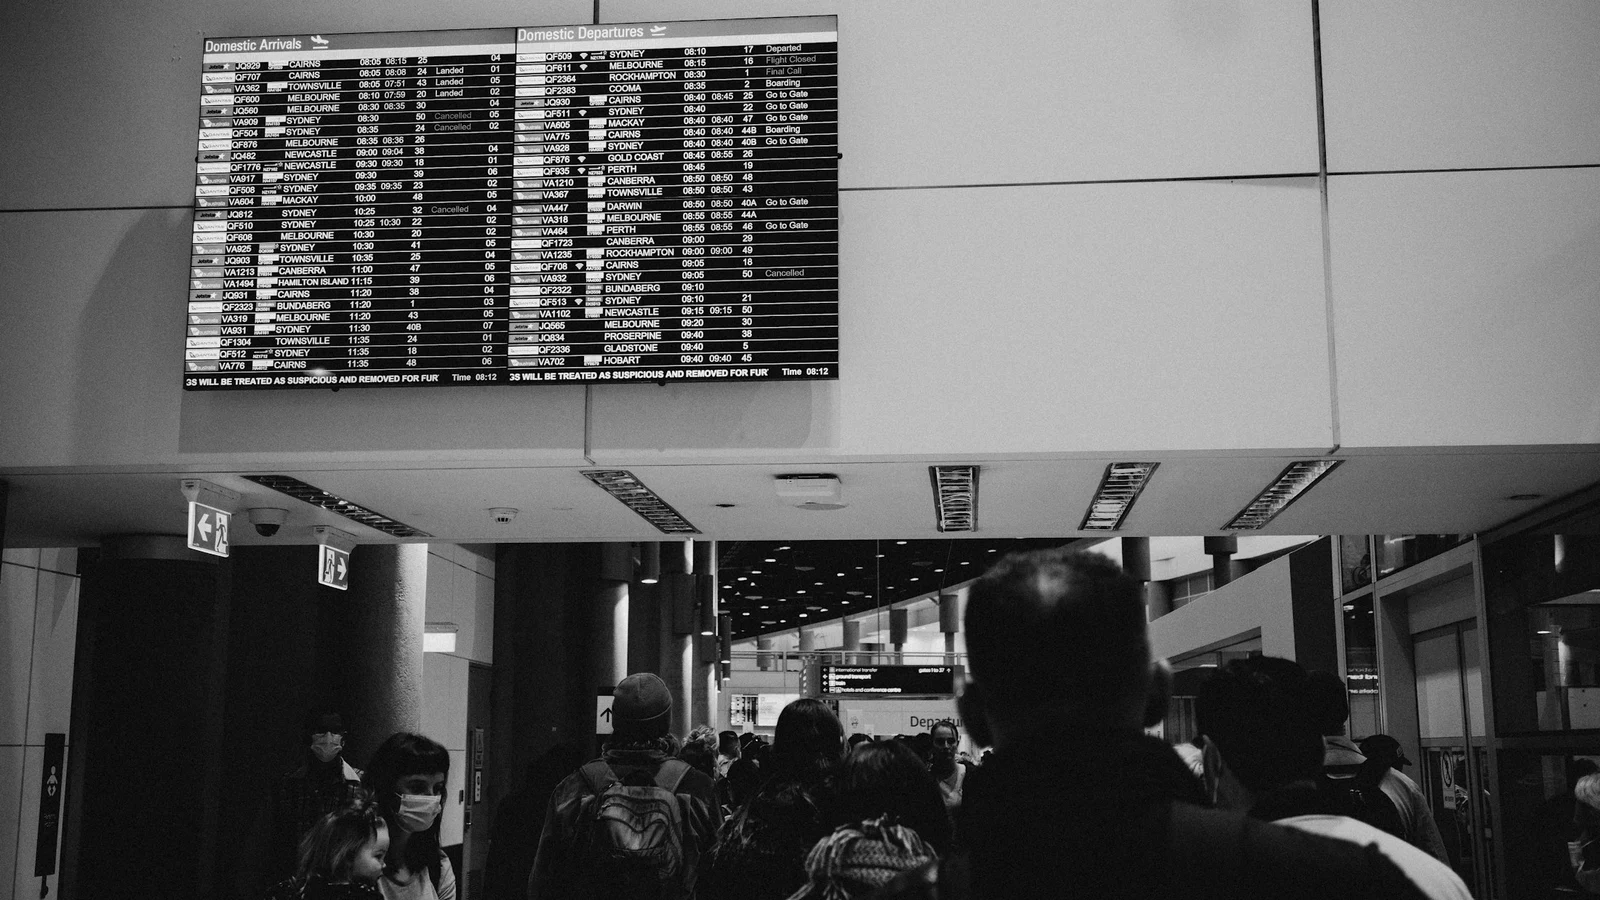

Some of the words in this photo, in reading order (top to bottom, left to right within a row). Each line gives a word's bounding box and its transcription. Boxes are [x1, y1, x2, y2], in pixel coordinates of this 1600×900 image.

[518, 27, 575, 41] Domestic
[578, 26, 644, 39] Departures
[205, 39, 257, 52] Domestic
[259, 38, 302, 50] Arrivals
[546, 52, 572, 61] QF509
[609, 50, 645, 58] SYDNEY
[766, 44, 801, 53] Departed
[235, 61, 261, 70] JQ929
[289, 60, 321, 68] CAIRNS
[609, 60, 663, 70] MELBOURNE
[766, 56, 787, 65] Flight
[789, 55, 816, 63] Closed
[235, 73, 261, 81] QF707
[288, 71, 320, 79] CAIRNS
[436, 66, 464, 75] Landed
[609, 72, 676, 81] ROCKHAMPTON
[786, 67, 802, 75] Call
[288, 82, 342, 90] TOWNSVILLE
[435, 78, 464, 86] Landed
[609, 84, 642, 93] COOMA
[766, 79, 801, 87] Boarding
[287, 93, 340, 102] MELBOURNE
[384, 91, 406, 99] 07:59
[435, 89, 463, 97] Landed
[545, 98, 570, 106] JQ930
[608, 96, 641, 104] CAIRNS
[765, 91, 778, 99] Go
[789, 90, 808, 98] Gate
[287, 104, 340, 113] MELBOURNE
[545, 110, 570, 118] QF511
[608, 107, 644, 116] SYDNEY
[232, 118, 259, 126] VA909
[286, 116, 321, 124] SYDNEY
[434, 112, 472, 120] Cancelled
[608, 119, 645, 127] MACKAY
[286, 128, 321, 136] SYDNEY
[434, 123, 472, 131] Cancelled
[608, 130, 641, 139] CAIRNS
[765, 125, 801, 134] Boarding
[285, 138, 338, 147] MELBOURNE
[608, 142, 644, 150] SYDNEY
[285, 150, 337, 158] NEWCASTLE
[608, 154, 633, 162] GOLD
[634, 153, 665, 161] COAST
[230, 163, 261, 172] QF1776
[284, 161, 336, 170] NEWCASTLE
[355, 160, 378, 168] 09:30
[607, 165, 637, 173] PERTH
[229, 175, 256, 183] VA917
[283, 173, 319, 181] SYDNEY
[543, 179, 574, 187] VA1210
[607, 176, 656, 185] CANBERRA
[283, 184, 318, 193] SYDNEY
[607, 188, 663, 197] TOWNSVILLE
[282, 196, 319, 204] MACKAY
[355, 194, 376, 202] 10:00
[542, 204, 569, 212] VA447
[607, 202, 642, 210] DARWIN
[765, 198, 778, 206] Go
[779, 198, 788, 206] to
[281, 209, 317, 217] SYDNEY
[354, 207, 376, 215] 10:25
[607, 213, 661, 222] MELBOURNE
[281, 220, 317, 229] SYDNEY
[606, 226, 636, 234] PERTH
[280, 232, 334, 240] MELBOURNE
[541, 239, 573, 248] QF1723
[606, 237, 655, 246] CANBERRA
[280, 244, 315, 252] SYDNEY
[541, 251, 572, 259] VA1235
[606, 248, 674, 257] ROCKHAMPTON
[225, 256, 251, 265] JQ903
[279, 254, 334, 263] TOWNSVILLE
[352, 254, 374, 262] 10:35
[224, 268, 255, 276] VA1213
[278, 267, 326, 275] CANBERRA
[351, 265, 373, 273] 11:00
[540, 262, 568, 271] QF708
[605, 261, 639, 269] CAIRNS
[605, 273, 642, 281] SYDNEY
[765, 269, 805, 277] Cancelled
[223, 280, 254, 288] VA1494
[278, 278, 319, 286] HAMILTON
[351, 277, 373, 285] 11:15
[605, 284, 661, 293] BUNDABERG
[681, 283, 704, 291] 09:10
[222, 291, 248, 300] JQ931
[277, 290, 310, 298] CAIRNS
[222, 303, 253, 311] QF2323
[277, 301, 331, 310] BUNDABERG
[540, 298, 567, 306] QF513
[605, 296, 641, 305] SYDNEY
[539, 310, 571, 318] VA1102
[605, 308, 659, 316] NEWCASTLE
[681, 307, 704, 315] 09:15
[709, 306, 732, 314] 09:15
[276, 313, 330, 322] MELBOURNE
[275, 325, 311, 333] SYDNEY
[604, 320, 660, 328] MELBOURNE
[220, 338, 251, 347] QF1304
[275, 337, 330, 345] TOWNSVILLE
[348, 336, 370, 344] 11:35
[539, 333, 565, 342] JQ834
[604, 332, 662, 340] PROSERPINE
[604, 344, 658, 352] GLADSTONE
[219, 350, 246, 358] QF512
[274, 349, 310, 357] SYDNEY
[218, 362, 245, 370] VA776
[274, 361, 307, 369] CAIRNS
[538, 358, 565, 366] VA702
[604, 356, 641, 364] HOBART
[558, 372, 597, 380] TREATED
[598, 371, 611, 379] AS
[612, 370, 664, 379] SUSPICIOUS
[665, 370, 684, 378] AND
[686, 369, 729, 377] REMOVED
[730, 369, 749, 377] FOR
[806, 367, 829, 375] 08:12
[198, 378, 219, 386] WILL
[234, 377, 273, 385] TREATED
[287, 375, 338, 384] SUSPICIOUS
[358, 375, 400, 383] REMOVED
[475, 373, 497, 381] 08:12
